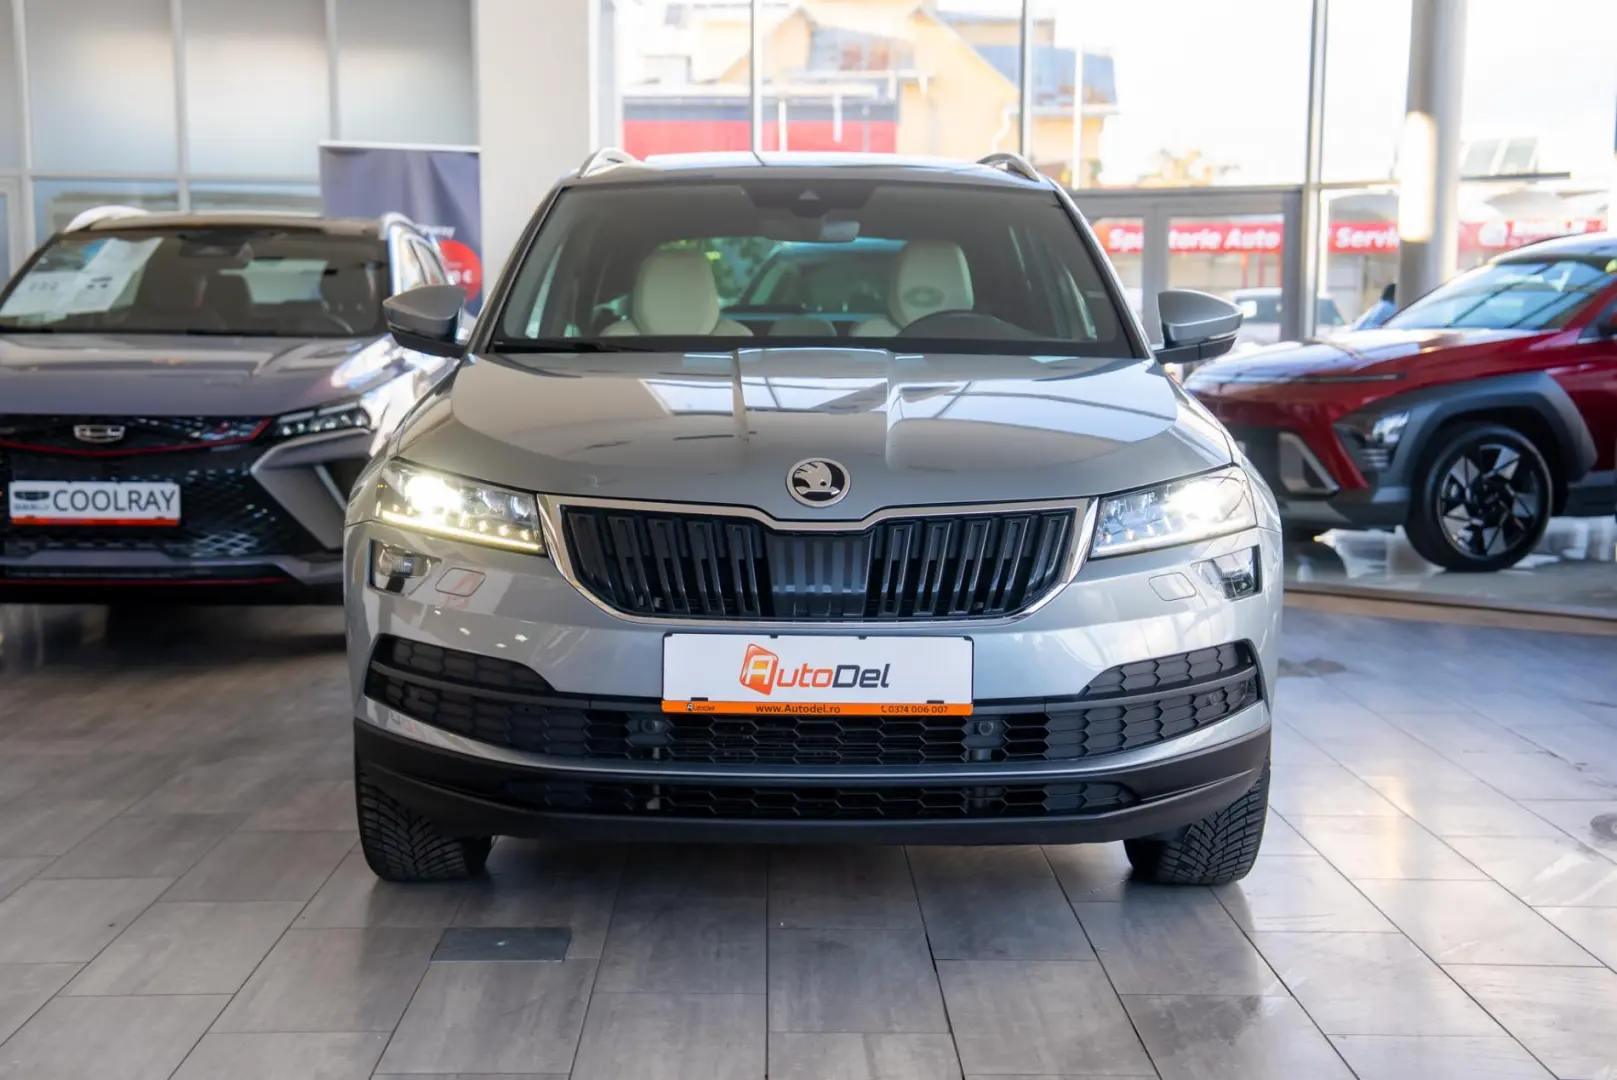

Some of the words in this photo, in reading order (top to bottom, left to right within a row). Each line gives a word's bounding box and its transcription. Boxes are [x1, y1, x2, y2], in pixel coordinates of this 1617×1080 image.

[1224, 228, 1281, 250] Auto
[52, 489, 175, 512] COOLRAY
[741, 648, 891, 691] AutoDel
[756, 703, 840, 713] www.Autodel.ro
[888, 704, 908, 714] 0374
[911, 705, 929, 714] 006
[931, 705, 949, 714] 007
